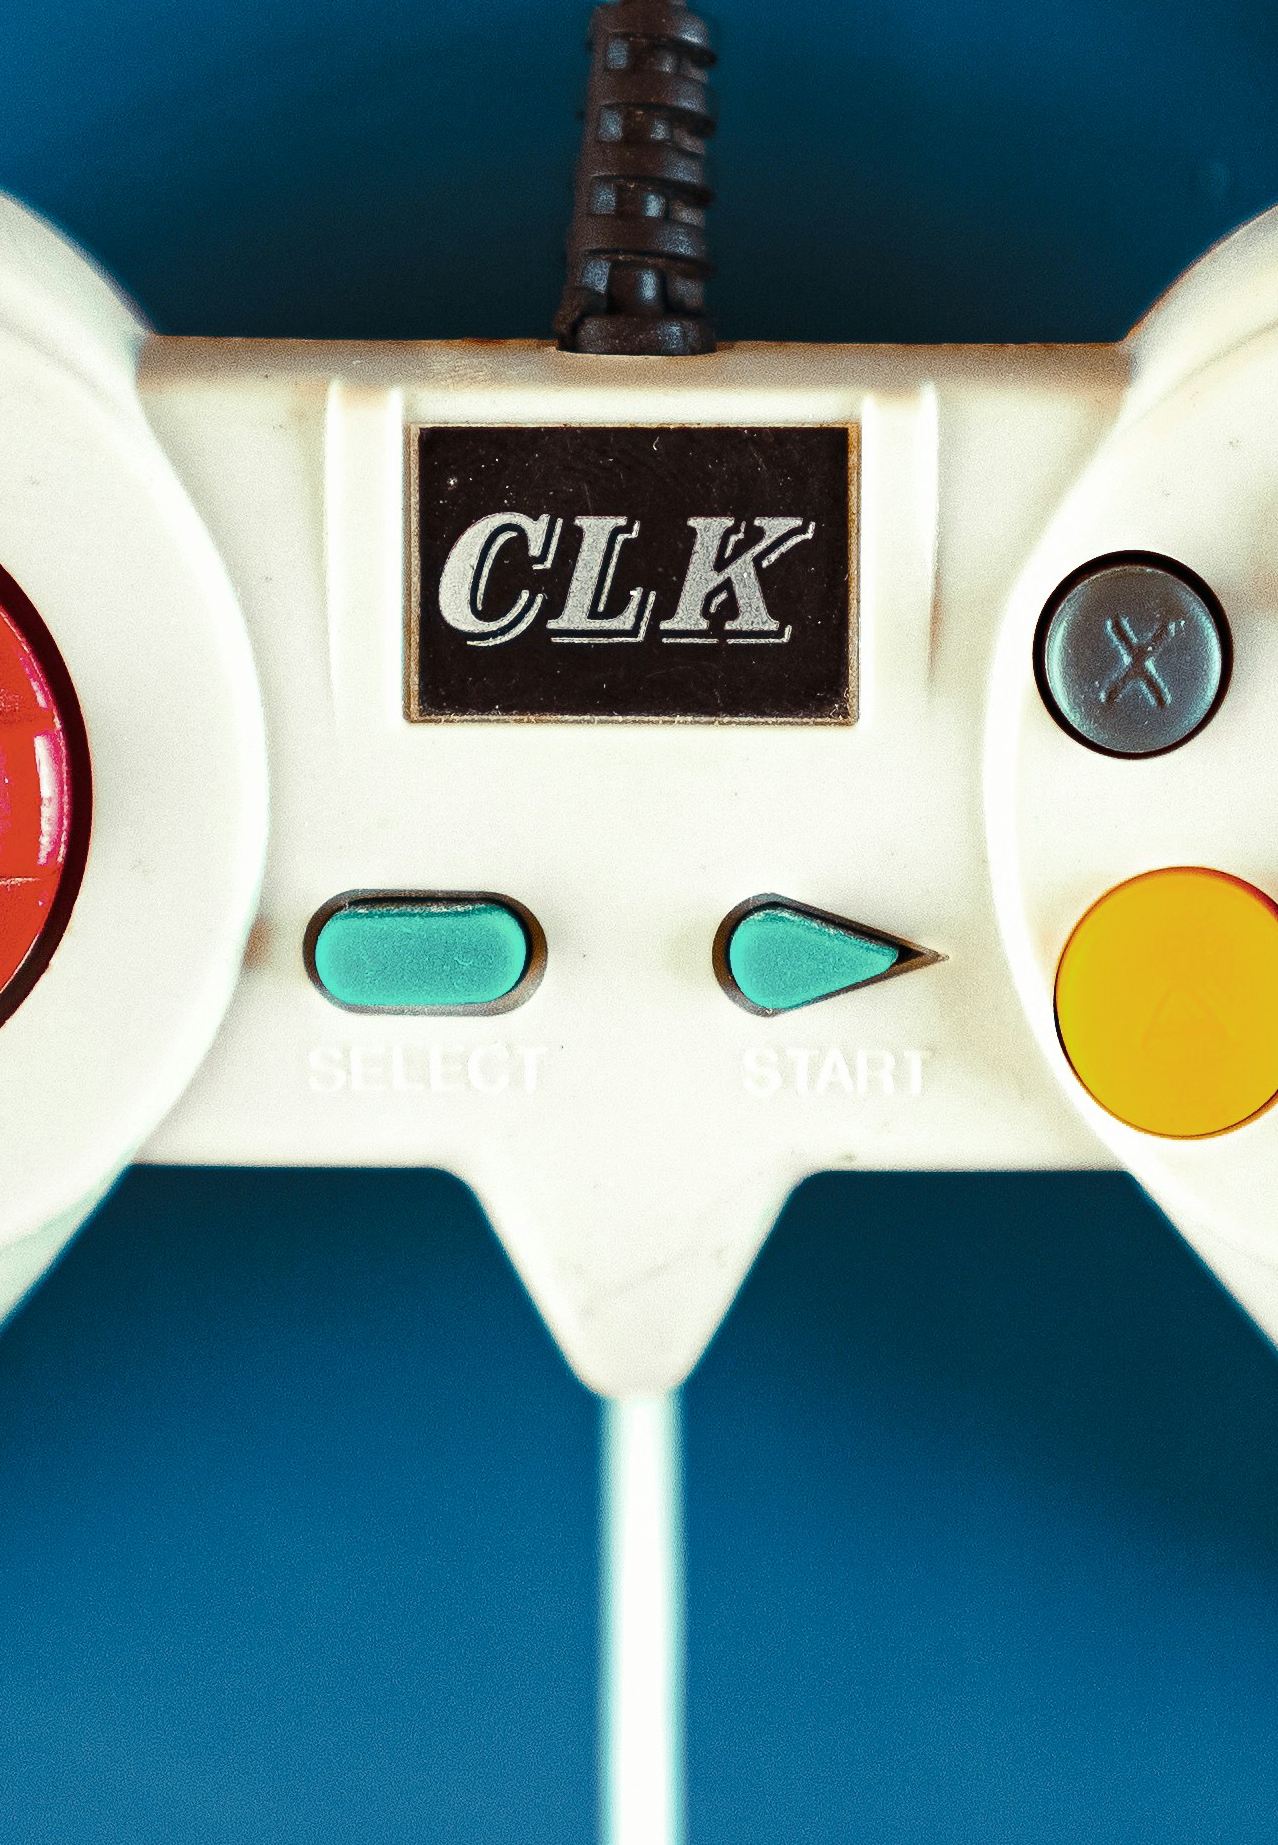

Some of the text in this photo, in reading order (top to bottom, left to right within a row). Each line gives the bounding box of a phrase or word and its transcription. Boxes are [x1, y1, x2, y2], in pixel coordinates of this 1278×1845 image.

[438, 511, 816, 646] CLK
[1096, 615, 1186, 709] X
[307, 1045, 548, 1095] SELECT
[741, 1047, 930, 1097] START
